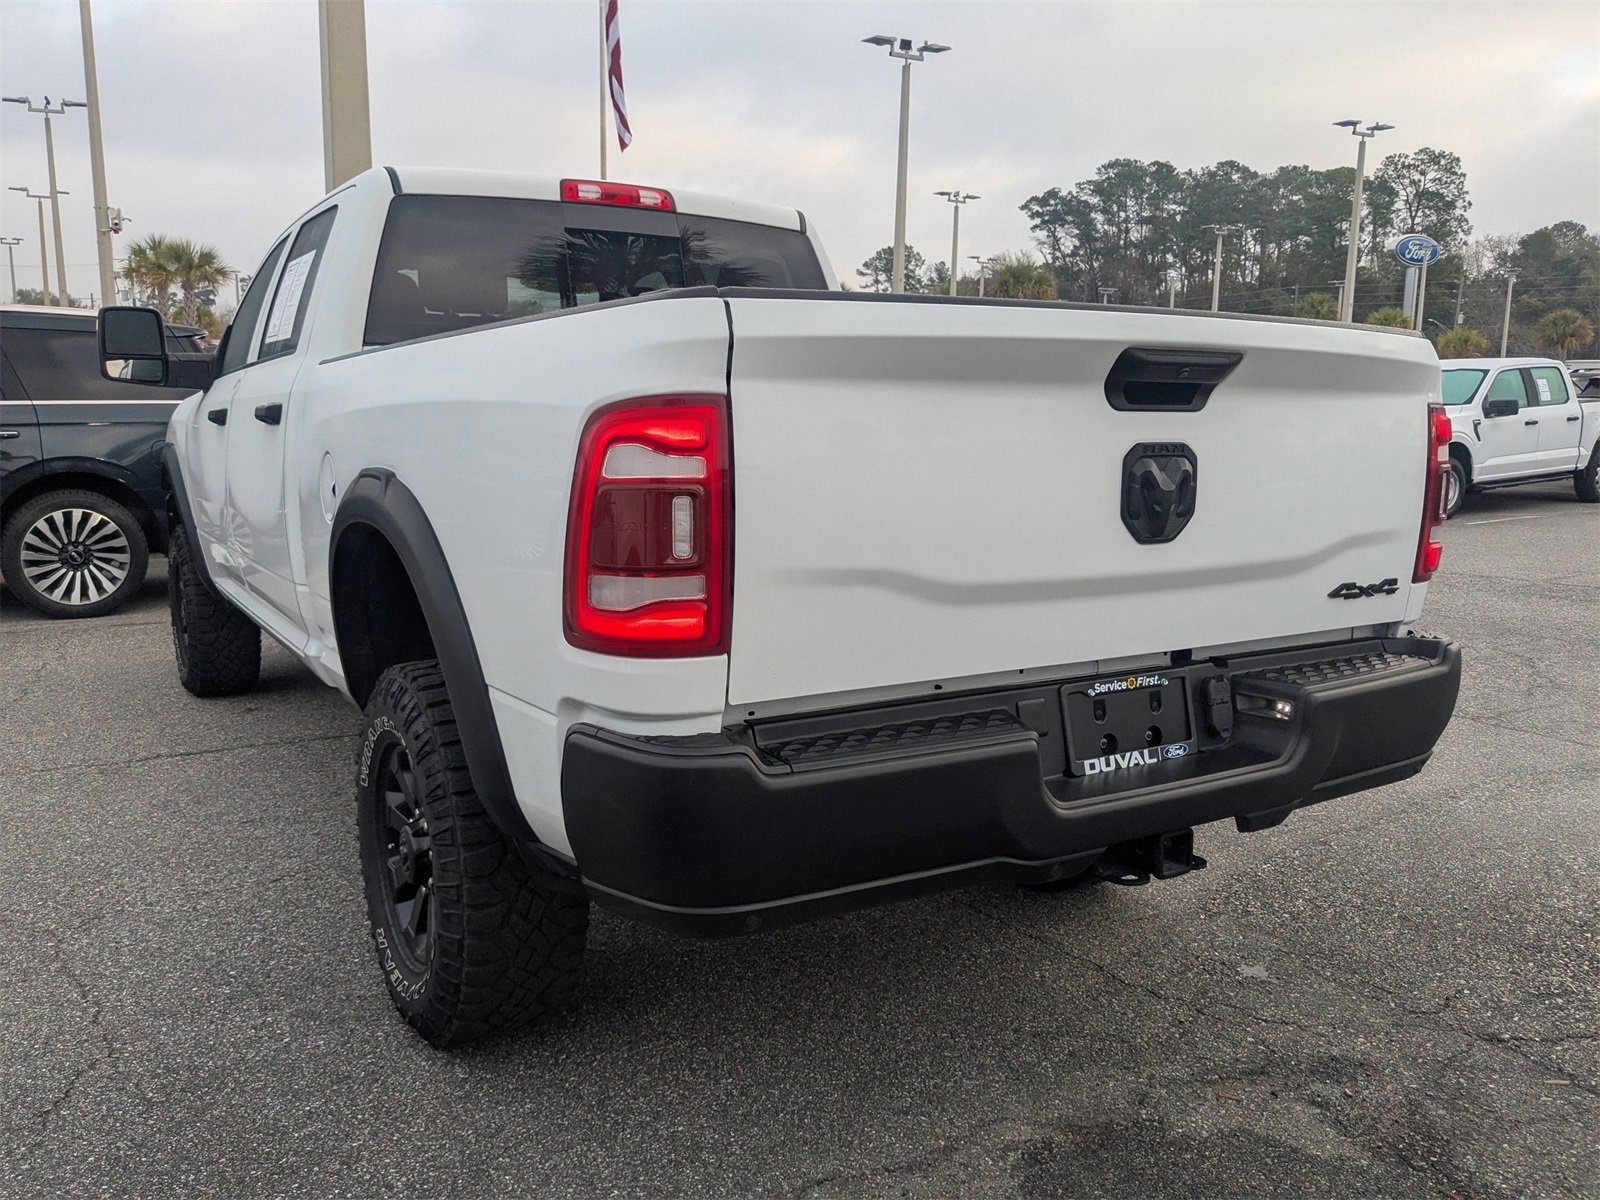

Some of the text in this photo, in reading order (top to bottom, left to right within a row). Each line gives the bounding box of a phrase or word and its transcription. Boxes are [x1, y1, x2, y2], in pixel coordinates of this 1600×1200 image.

[1405, 240, 1433, 260] Ford
[1142, 443, 1185, 454] RAM
[1094, 680, 1127, 693] Service
[360, 715, 415, 787] WRANGL
[1084, 745, 1185, 775] DUVAL Ford
